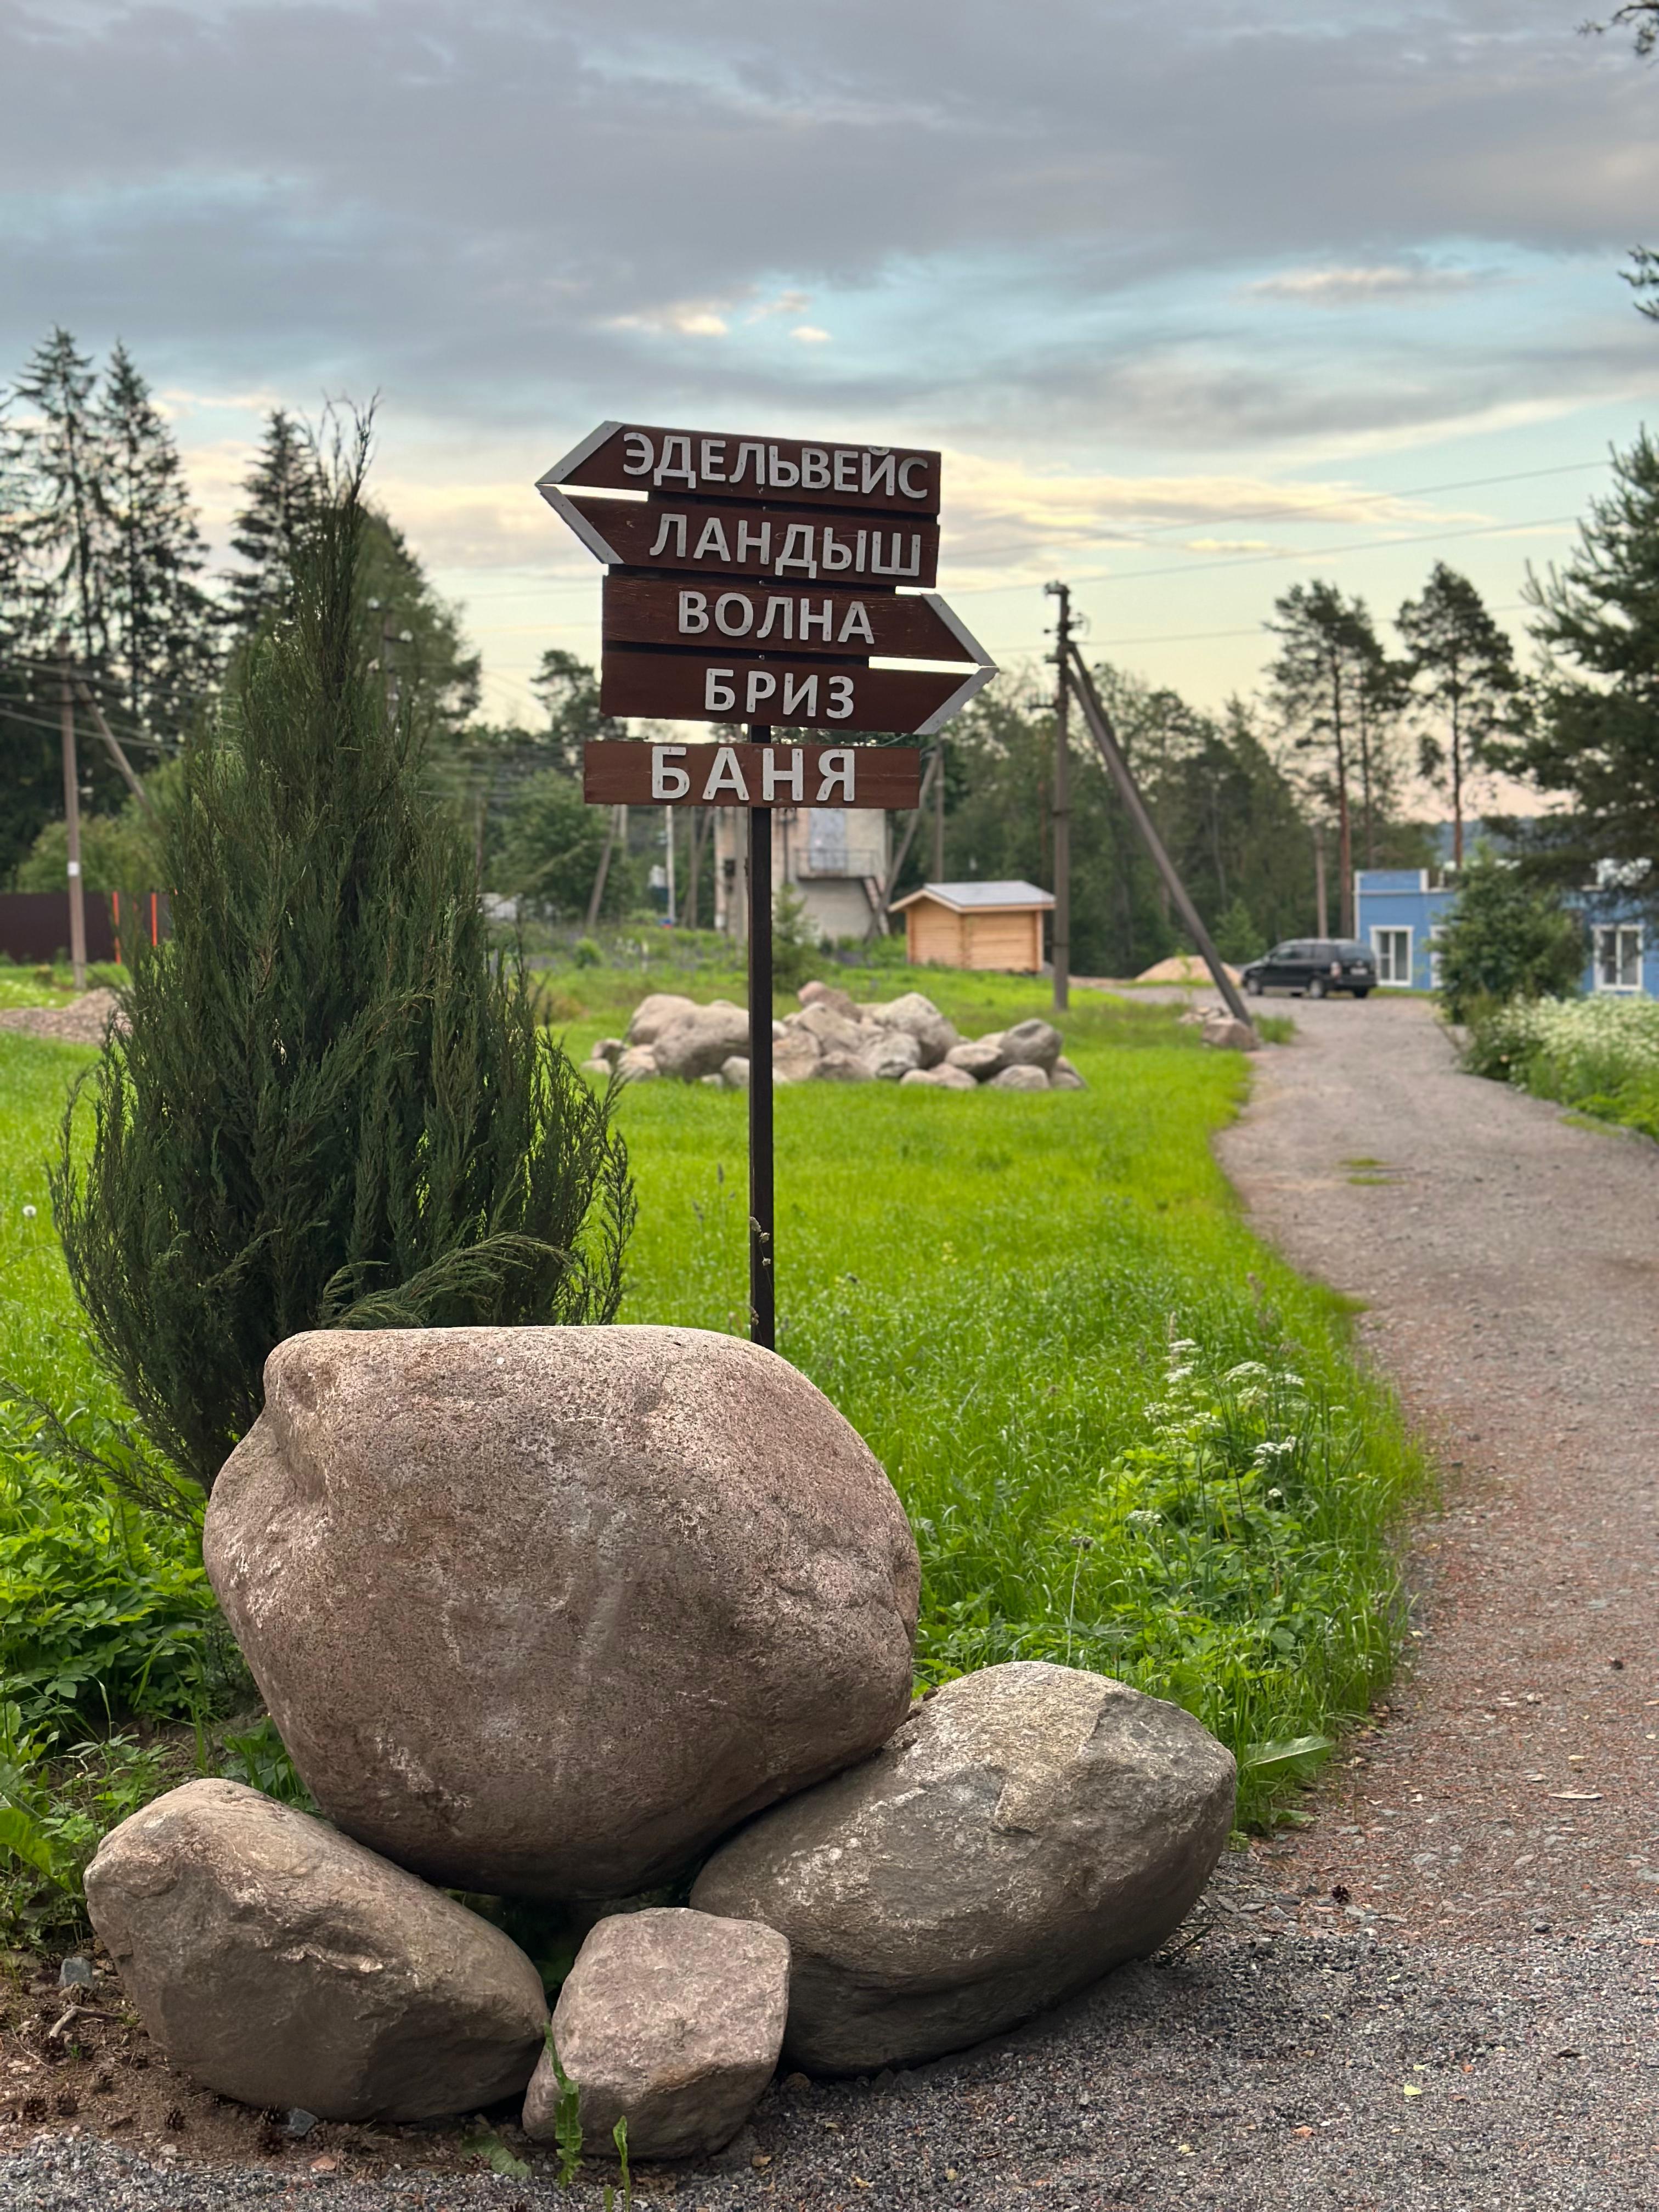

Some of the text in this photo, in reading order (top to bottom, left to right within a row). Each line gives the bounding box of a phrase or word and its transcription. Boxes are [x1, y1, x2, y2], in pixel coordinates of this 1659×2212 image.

[623, 432, 928, 498] ЭДЕЛЬВЕЙС
[650, 514, 921, 578] ЛАНДЫШ
[678, 591, 874, 644] ВОЛНА
[705, 668, 854, 719] БРИЗ
[652, 746, 856, 802] БАНЯ
